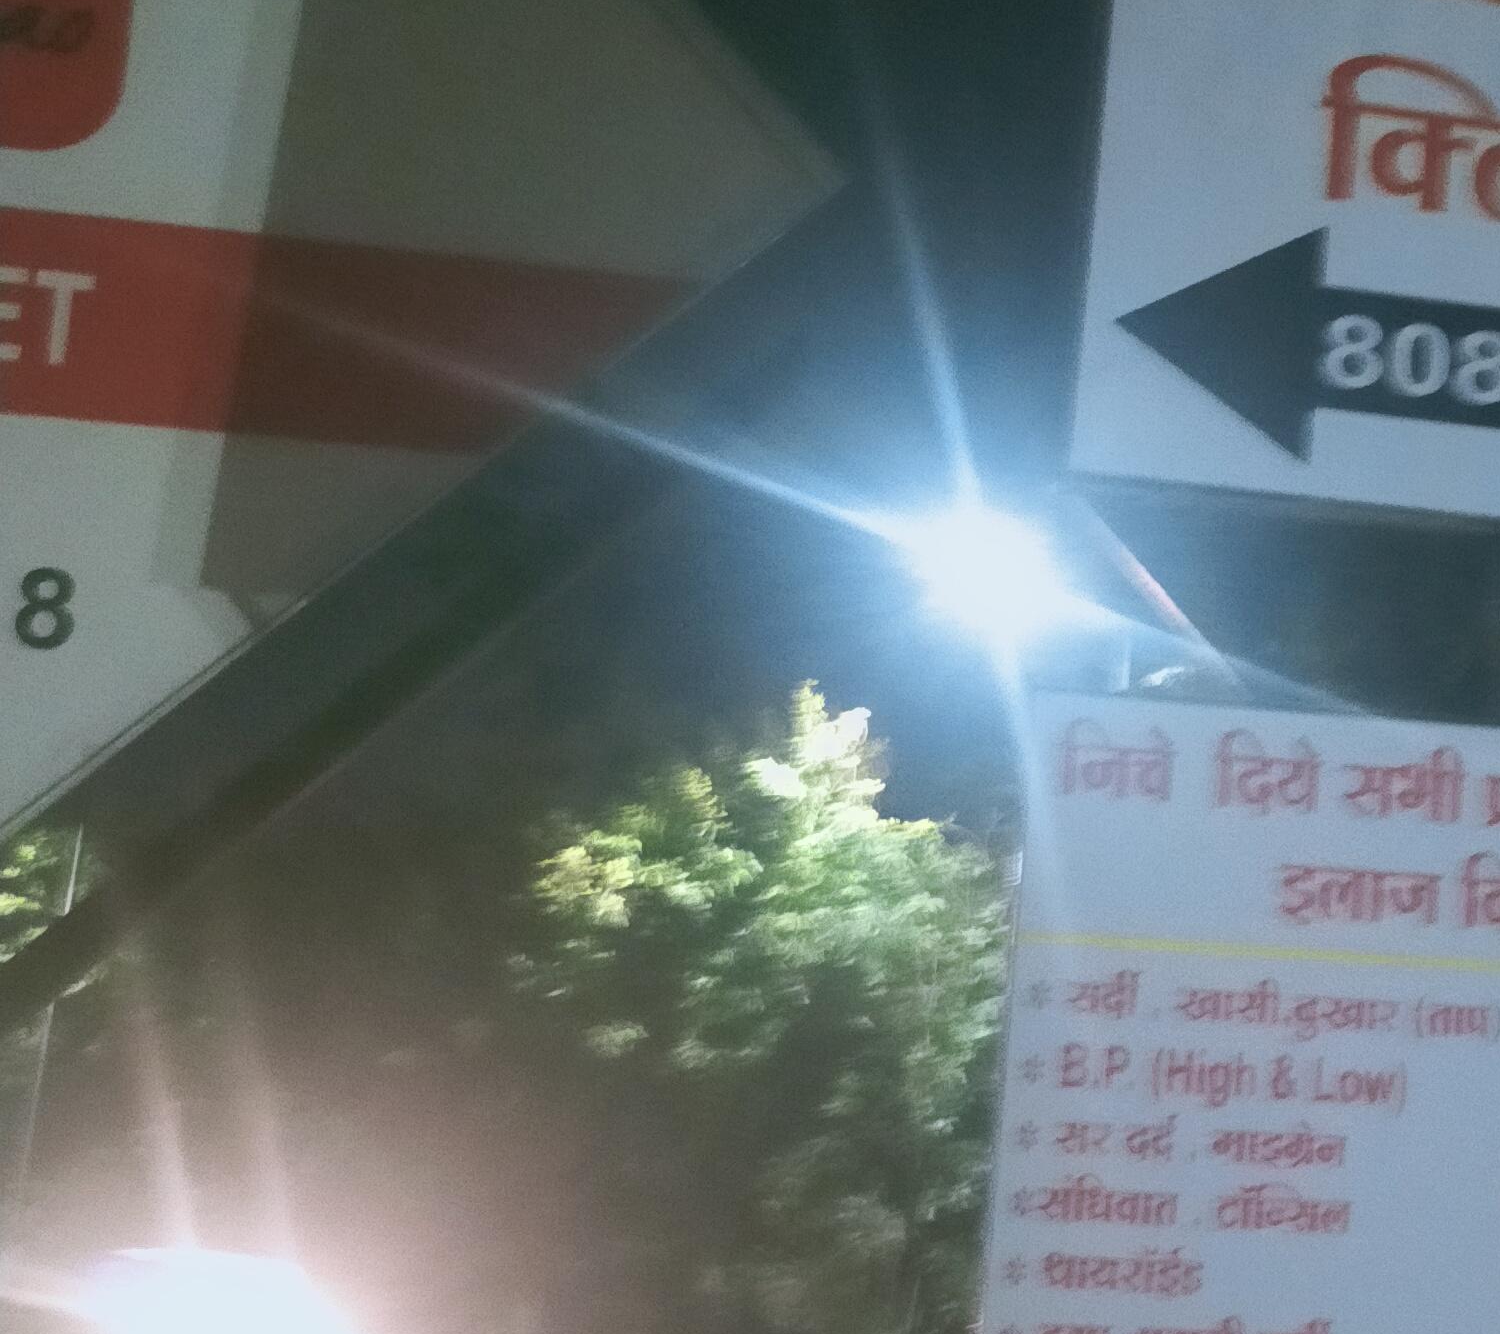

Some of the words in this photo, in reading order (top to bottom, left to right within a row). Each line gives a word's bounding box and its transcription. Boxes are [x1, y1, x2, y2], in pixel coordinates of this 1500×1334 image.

[14, 567, 76, 652] 8
[1341, 743, 1466, 827] सभी
[1273, 857, 1443, 929] इलाज
[1151, 1046, 1256, 1108] (High
[1269, 1053, 1298, 1100] &
[1313, 1056, 1409, 1115] Low)
